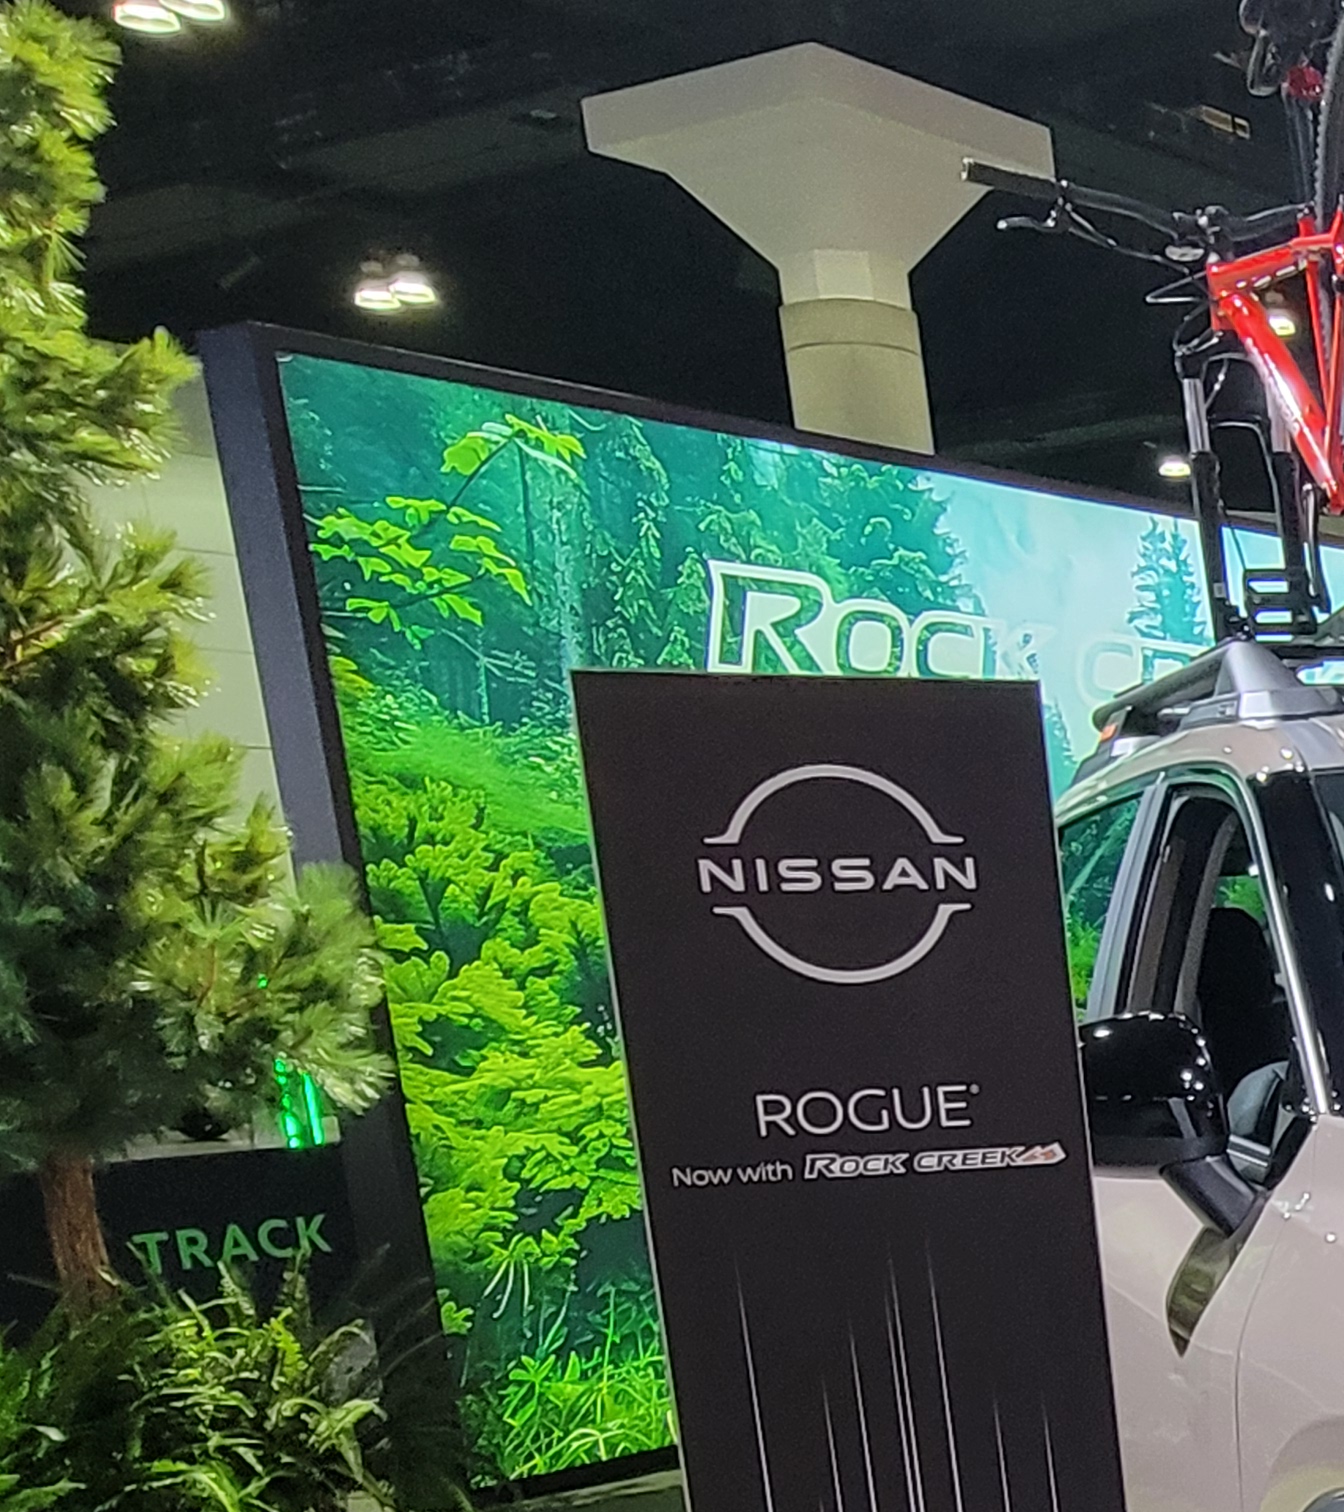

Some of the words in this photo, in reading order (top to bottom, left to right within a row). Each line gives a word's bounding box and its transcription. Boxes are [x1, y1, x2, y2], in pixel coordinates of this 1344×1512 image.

[697, 856, 979, 893] NISSAN
[755, 1084, 973, 1138] ROGUE
[671, 1166, 732, 1188] Now
[736, 1159, 794, 1184] with
[913, 1145, 1023, 1173] CREEK
[131, 1213, 333, 1275] TRACK
